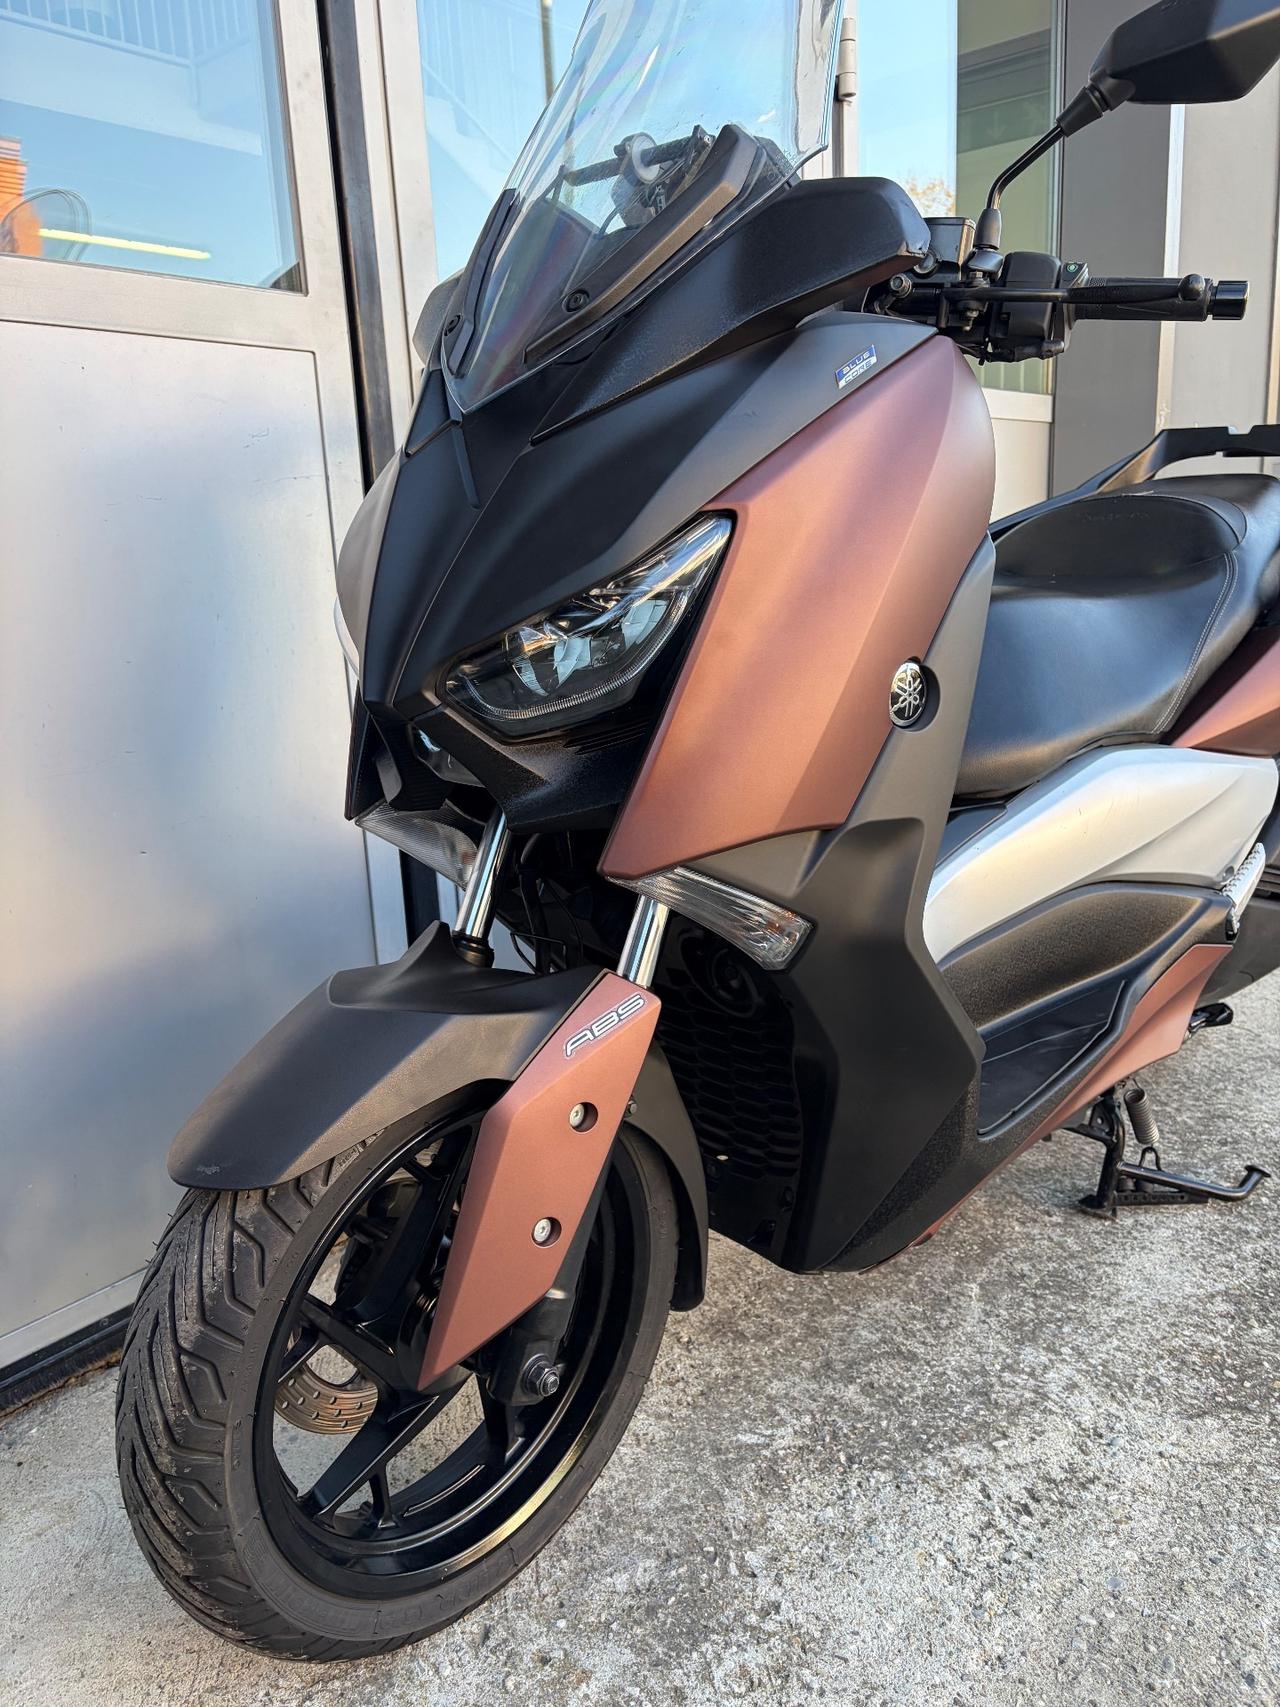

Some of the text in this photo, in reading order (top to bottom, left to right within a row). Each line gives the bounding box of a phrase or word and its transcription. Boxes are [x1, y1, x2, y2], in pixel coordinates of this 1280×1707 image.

[842, 350, 870, 375] BLUE
[844, 360, 873, 384] CORE
[565, 993, 646, 1058] ABS
